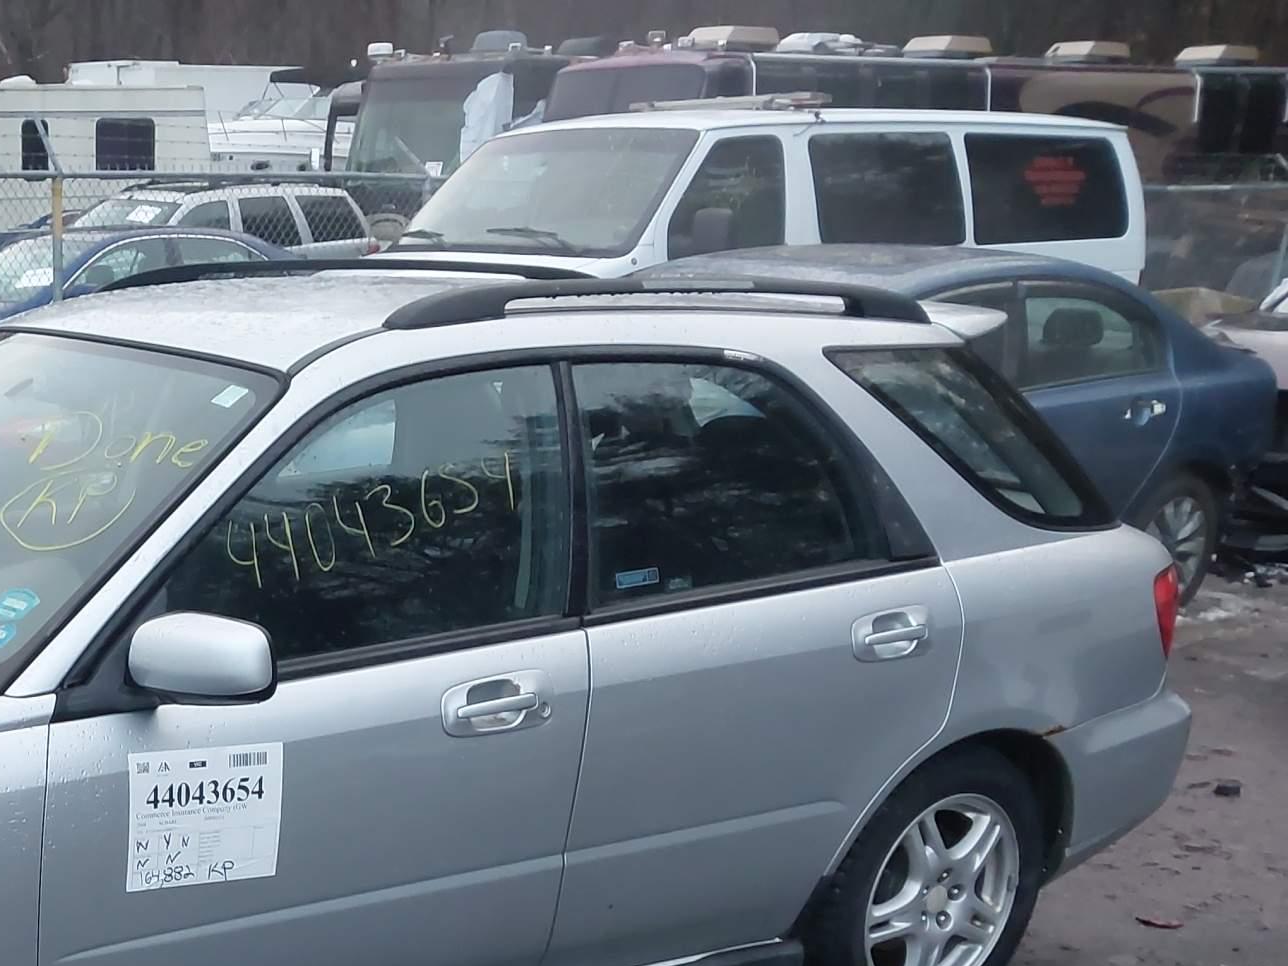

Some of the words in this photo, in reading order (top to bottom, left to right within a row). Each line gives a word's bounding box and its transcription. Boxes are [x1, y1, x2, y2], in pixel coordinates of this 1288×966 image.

[28, 411, 208, 470] Done
[227, 451, 514, 588] 44043654
[146, 776, 265, 809] 44043654
